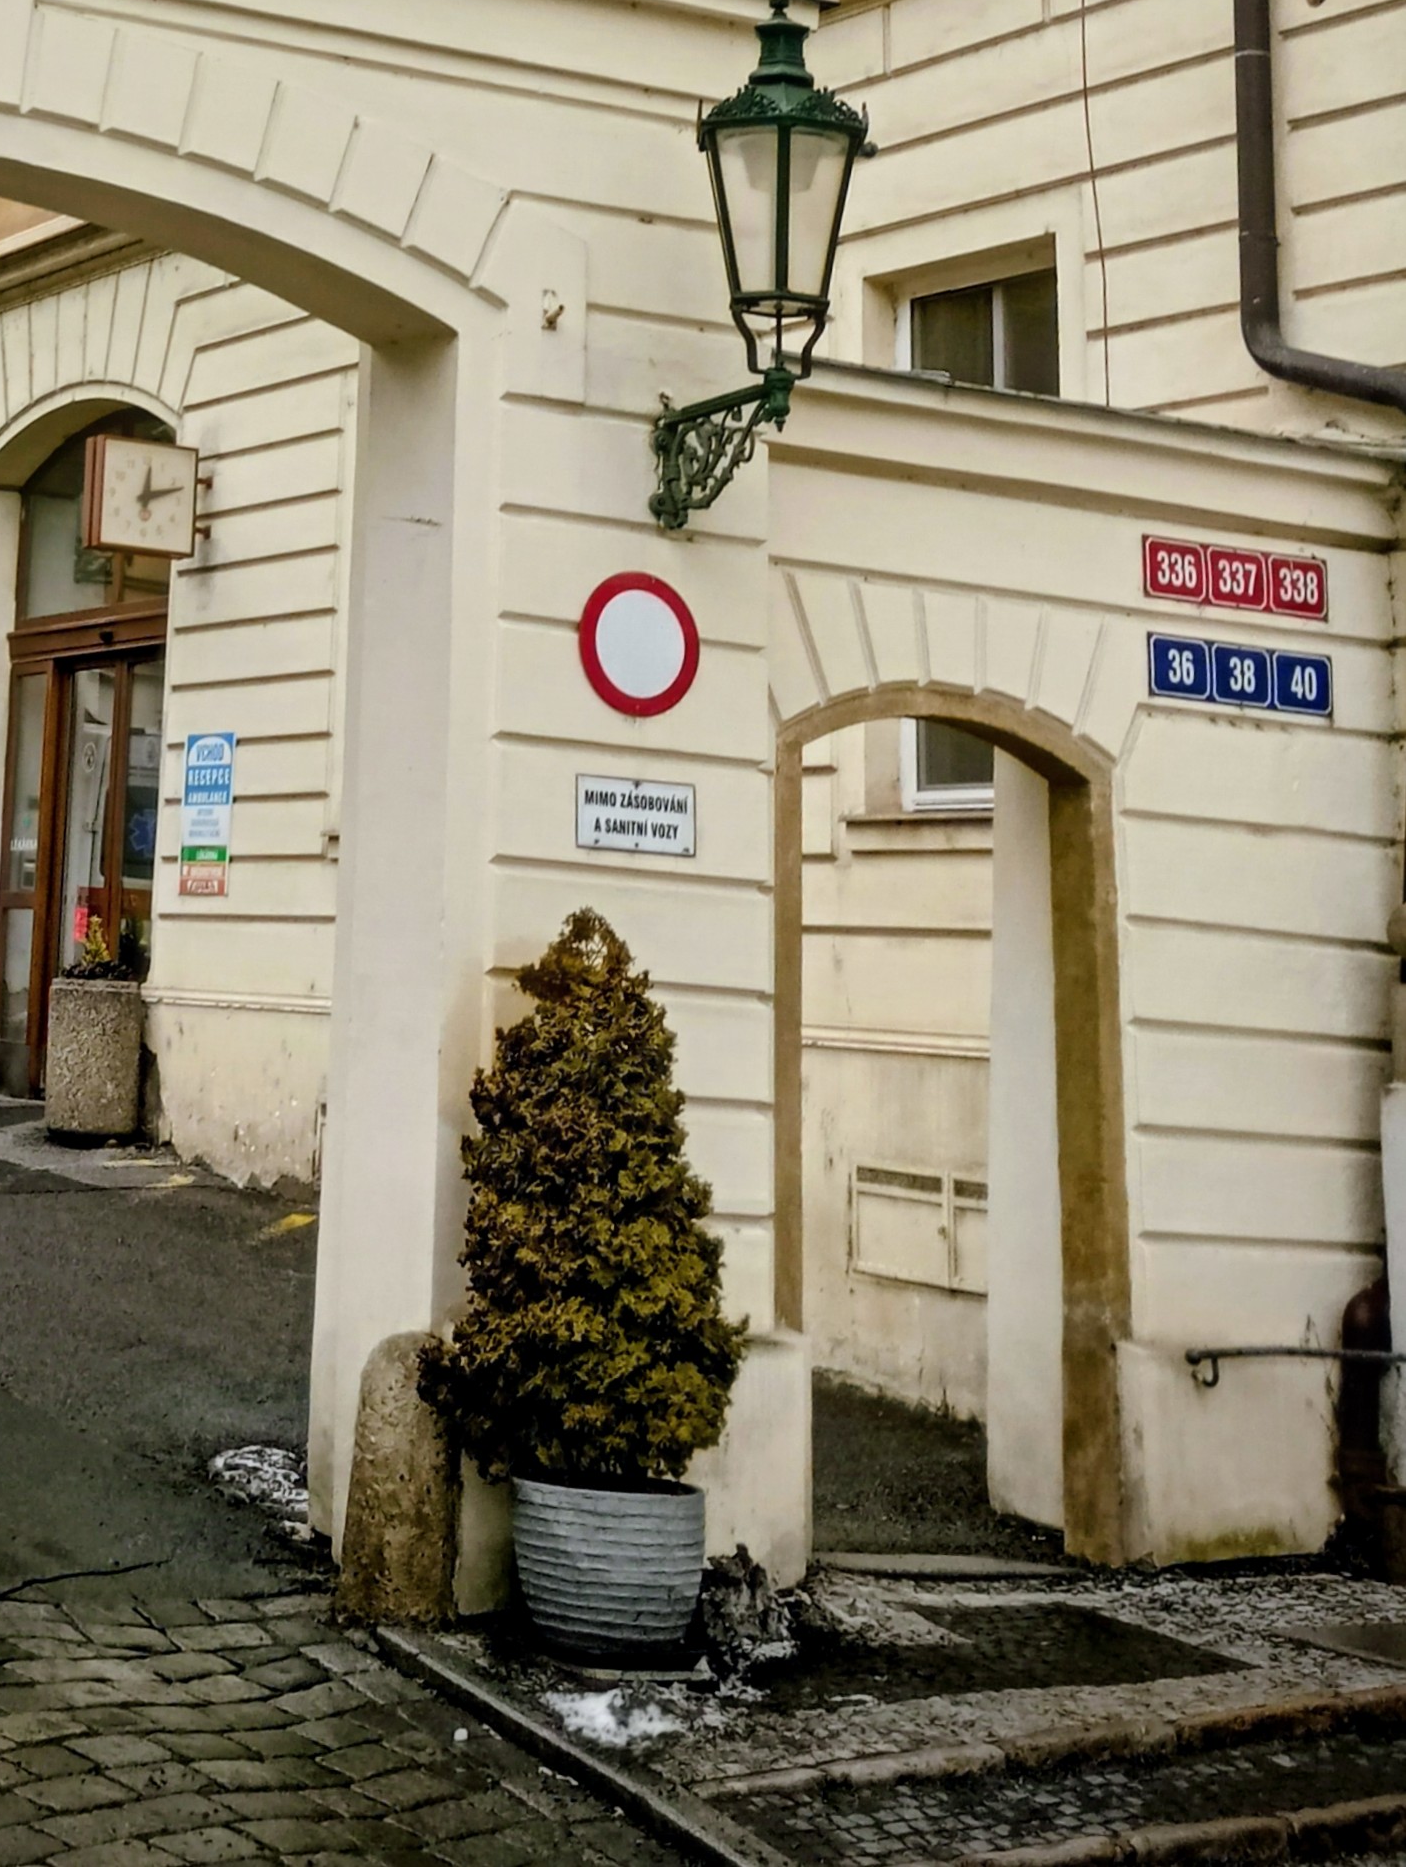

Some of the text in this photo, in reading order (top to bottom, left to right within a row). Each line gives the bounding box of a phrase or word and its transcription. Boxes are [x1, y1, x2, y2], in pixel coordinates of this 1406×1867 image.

[1157, 550, 1318, 605] 336 337 338
[1168, 648, 1317, 702] 36 38 40
[584, 789, 689, 815] MIMO ZÁSOBOVÁNÍ
[594, 817, 679, 840] A SANITNÍ VOZY
